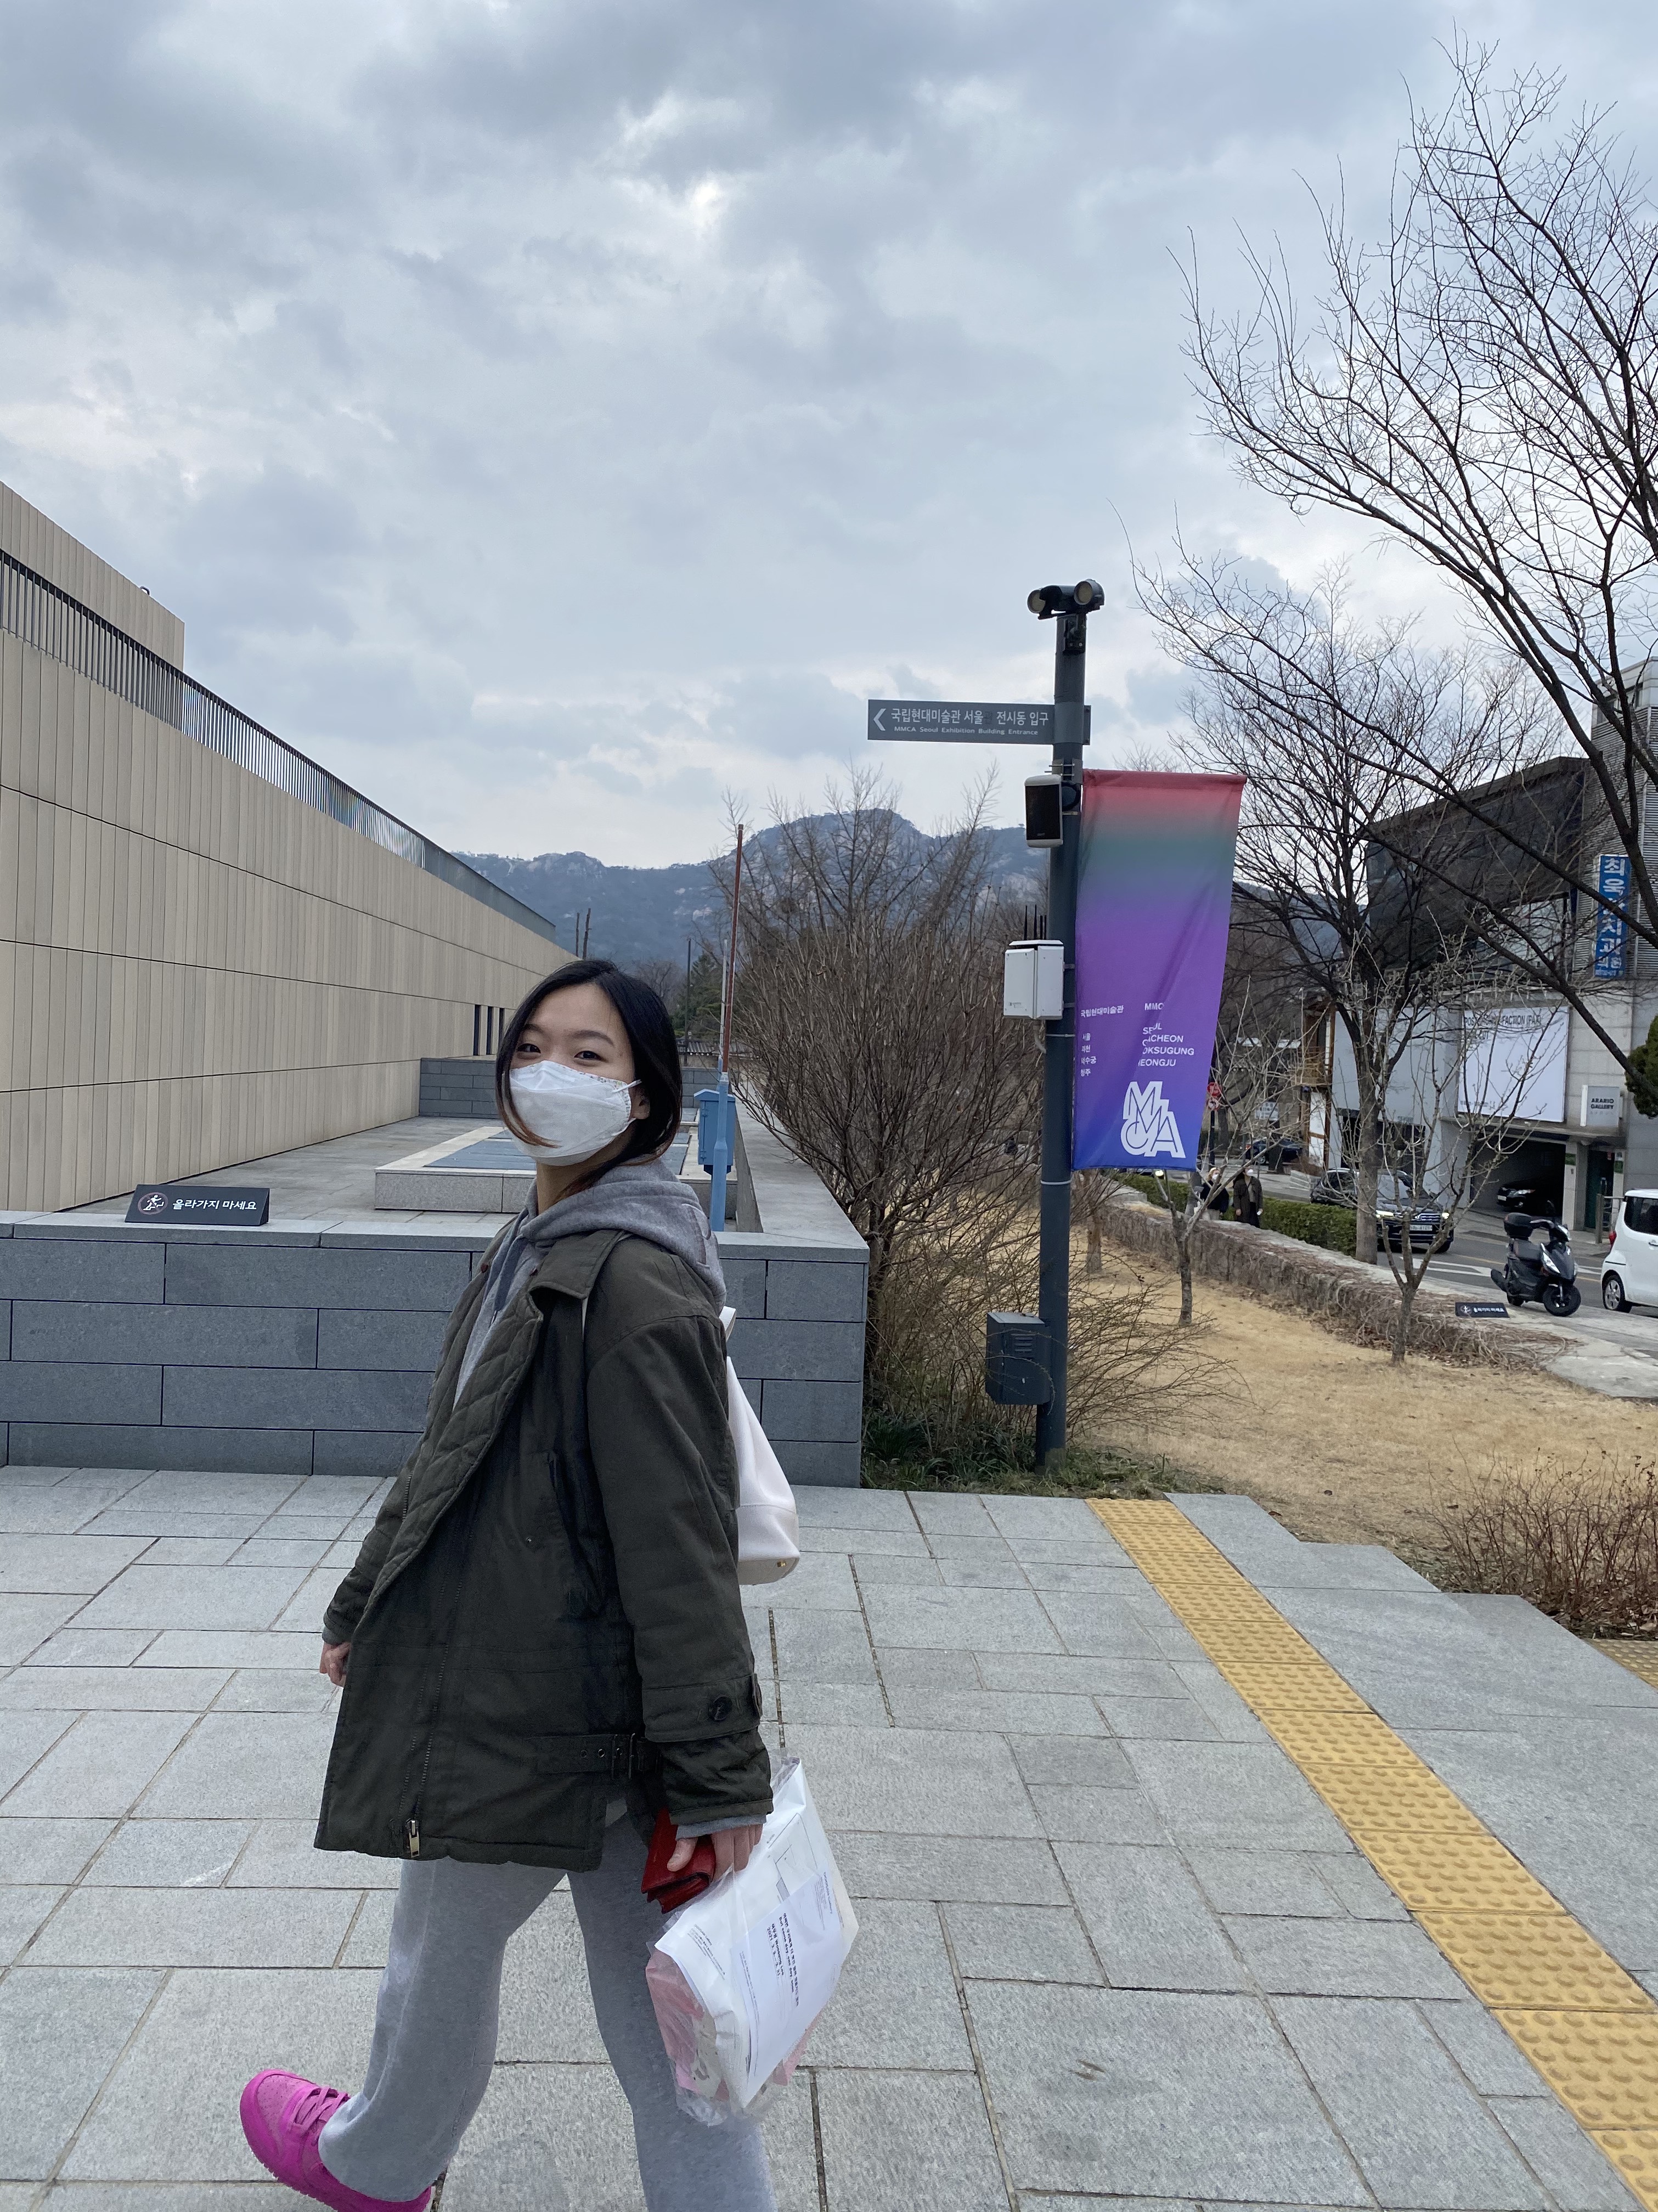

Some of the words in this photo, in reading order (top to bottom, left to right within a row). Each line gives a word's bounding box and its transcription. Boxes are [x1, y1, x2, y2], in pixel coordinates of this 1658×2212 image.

[891, 708, 961, 724] 국립현대미술관
[963, 710, 984, 725] 서울
[996, 711, 1027, 726] 전시동
[1029, 712, 1048, 726] 입구
[172, 1199, 219, 1210] 올라가지
[222, 1200, 257, 1210] 마세요
